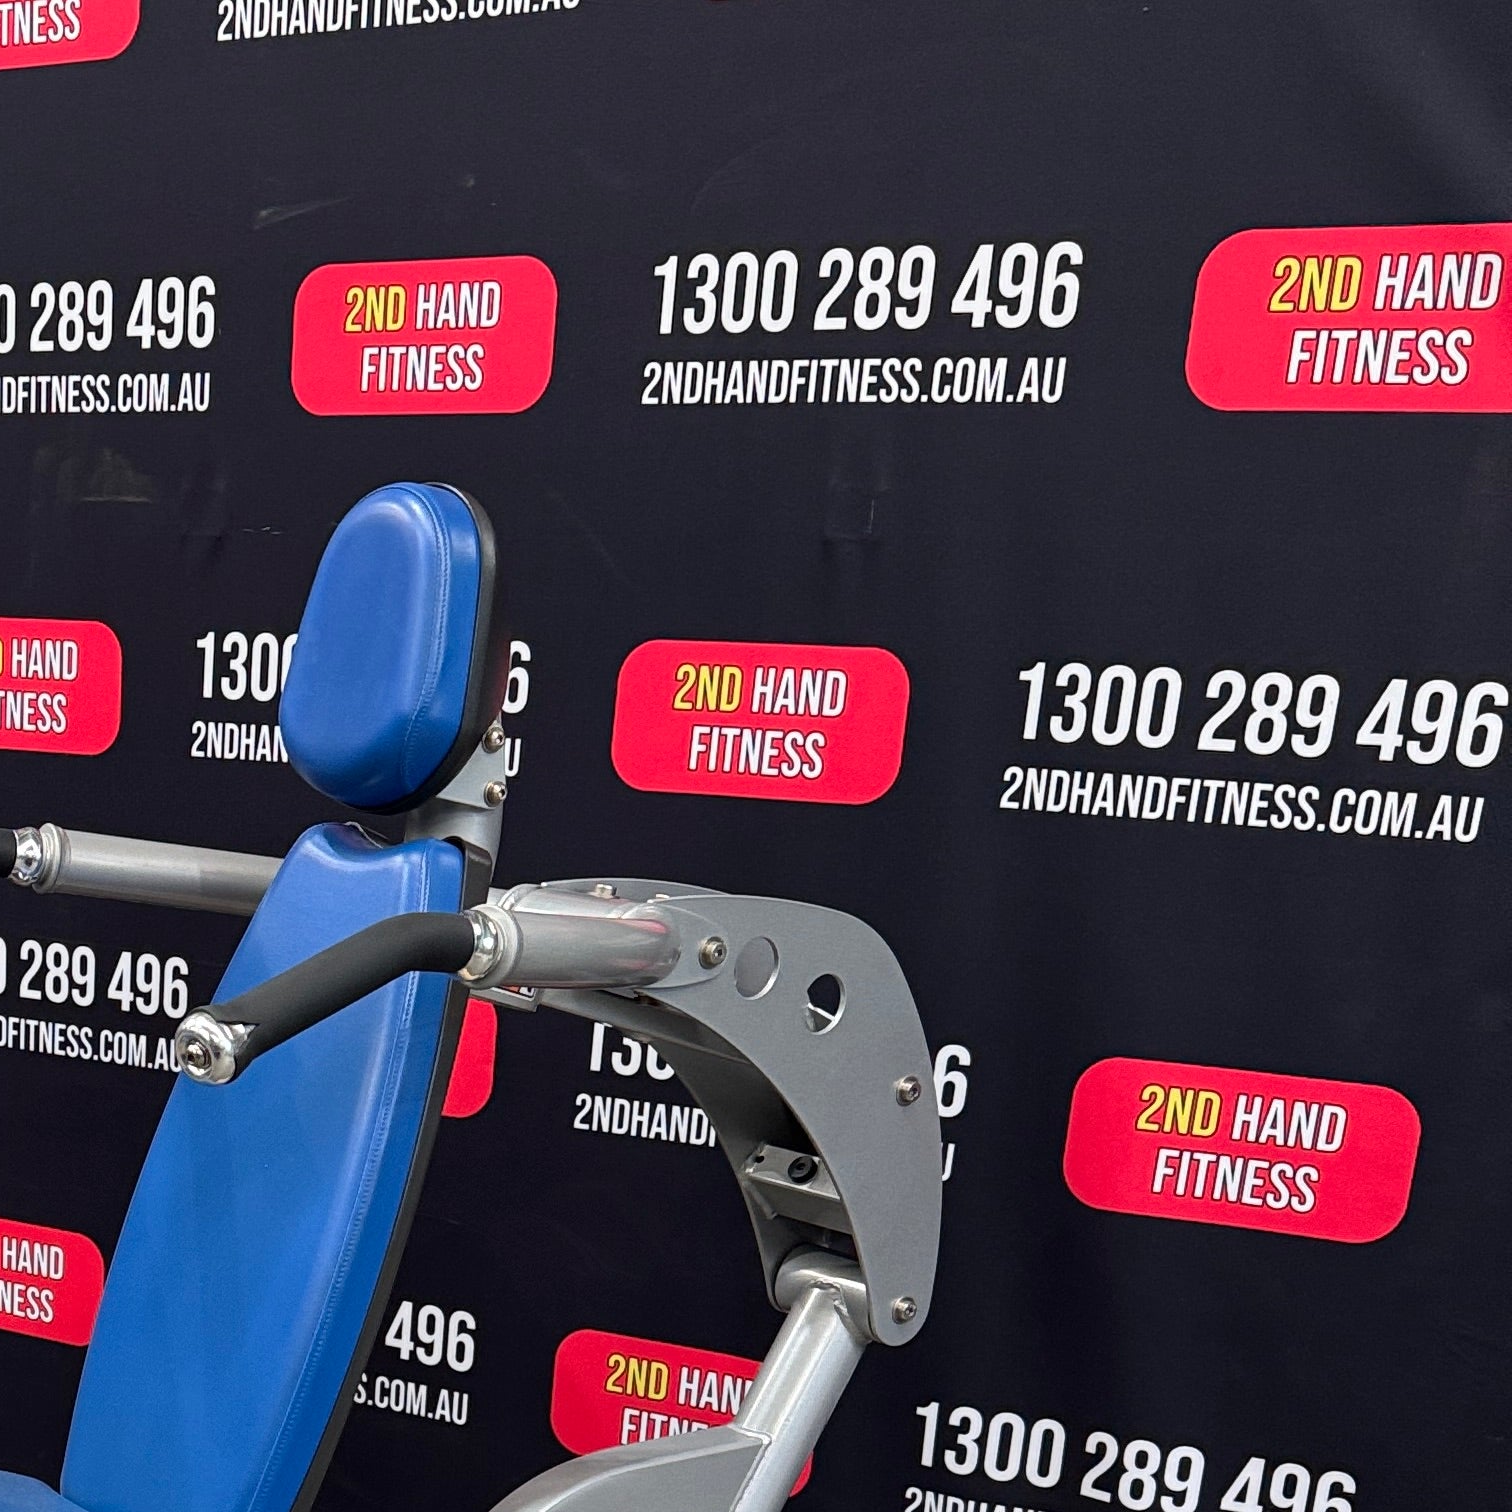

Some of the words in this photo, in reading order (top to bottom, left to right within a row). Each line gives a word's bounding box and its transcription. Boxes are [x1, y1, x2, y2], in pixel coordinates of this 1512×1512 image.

[345, 285, 406, 332] 2ND
[415, 281, 501, 330] HAND
[653, 249, 799, 335] 1300
[813, 244, 936, 331] 289
[950, 241, 1084, 329] 496
[1269, 256, 1362, 312] 2ND
[1374, 253, 1502, 310] HAND
[29, 279, 114, 352] 289
[126, 275, 216, 350] 496
[361, 343, 484, 392] FITNESS
[641, 356, 1067, 405] 2NDHANDFITNESS.COM.AU
[1287, 329, 1473, 385] FITNESS
[11, 638, 78, 681] HAND
[673, 663, 743, 712] 2ND
[751, 667, 847, 717] HAND
[1018, 661, 1183, 749] 1300
[1197, 669, 1341, 758] 289
[1355, 678, 1509, 768] 496
[689, 725, 825, 779] FITNESS
[999, 765, 1485, 843] 2NDHANDFITNESS.COM.AU
[19, 939, 96, 1007] 289
[106, 951, 190, 1021] 496
[1136, 1085, 1221, 1137] 2ND
[1231, 1094, 1347, 1152] HAND
[1152, 1148, 1319, 1213] FITNESS
[2, 1236, 64, 1280] HAND
[384, 1300, 477, 1373] 496
[606, 1354, 669, 1400] 2ND
[915, 1401, 1066, 1488] 1300
